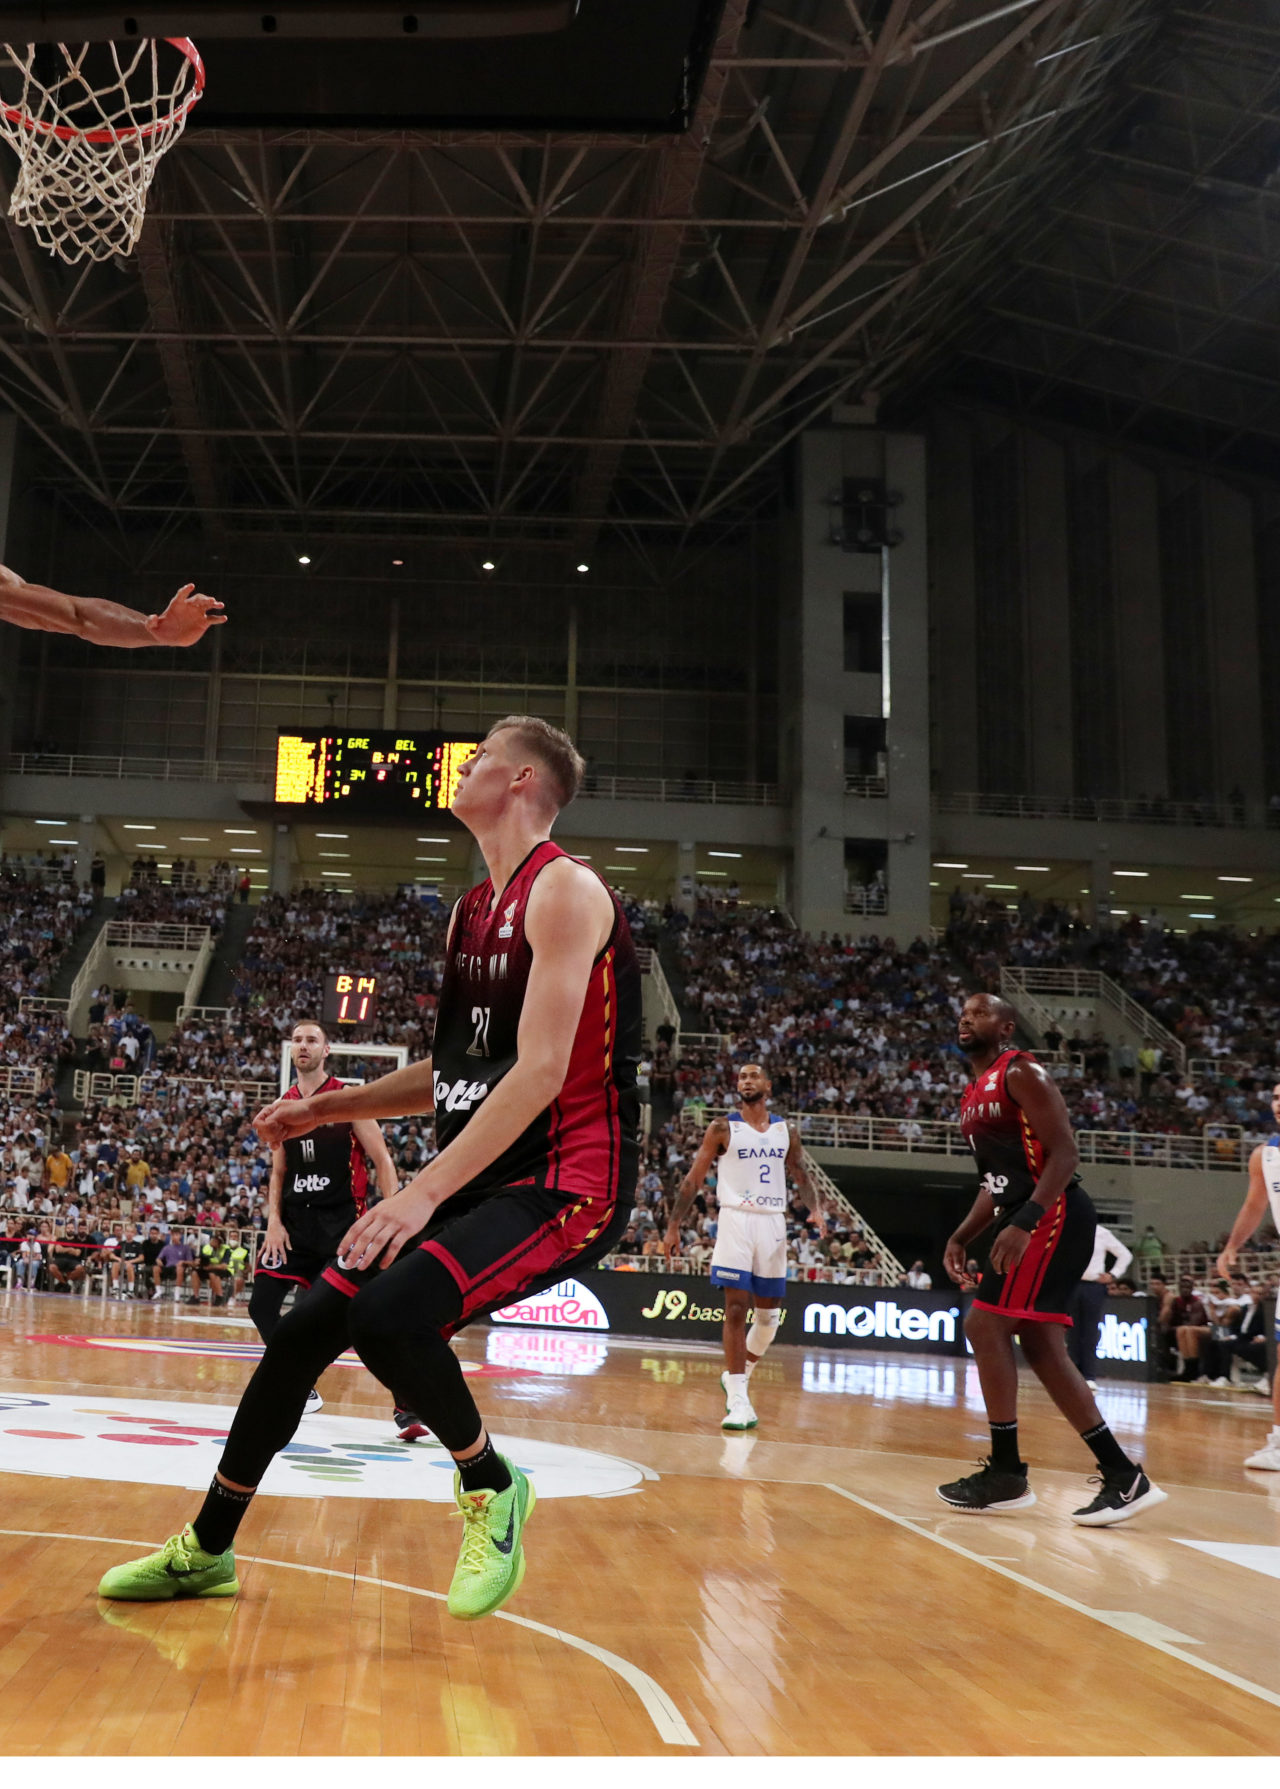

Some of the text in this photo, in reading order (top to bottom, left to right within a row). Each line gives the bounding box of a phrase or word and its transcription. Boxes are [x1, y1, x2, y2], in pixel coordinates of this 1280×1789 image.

[347, 738, 370, 749] GRE
[395, 739, 417, 751] BEL
[336, 975, 376, 994] 8:14
[465, 1006, 491, 1057] 21
[738, 1148, 785, 1160] ΕΛΛΑΣ
[759, 1164, 771, 1184] 2
[803, 1300, 957, 1342] molten
